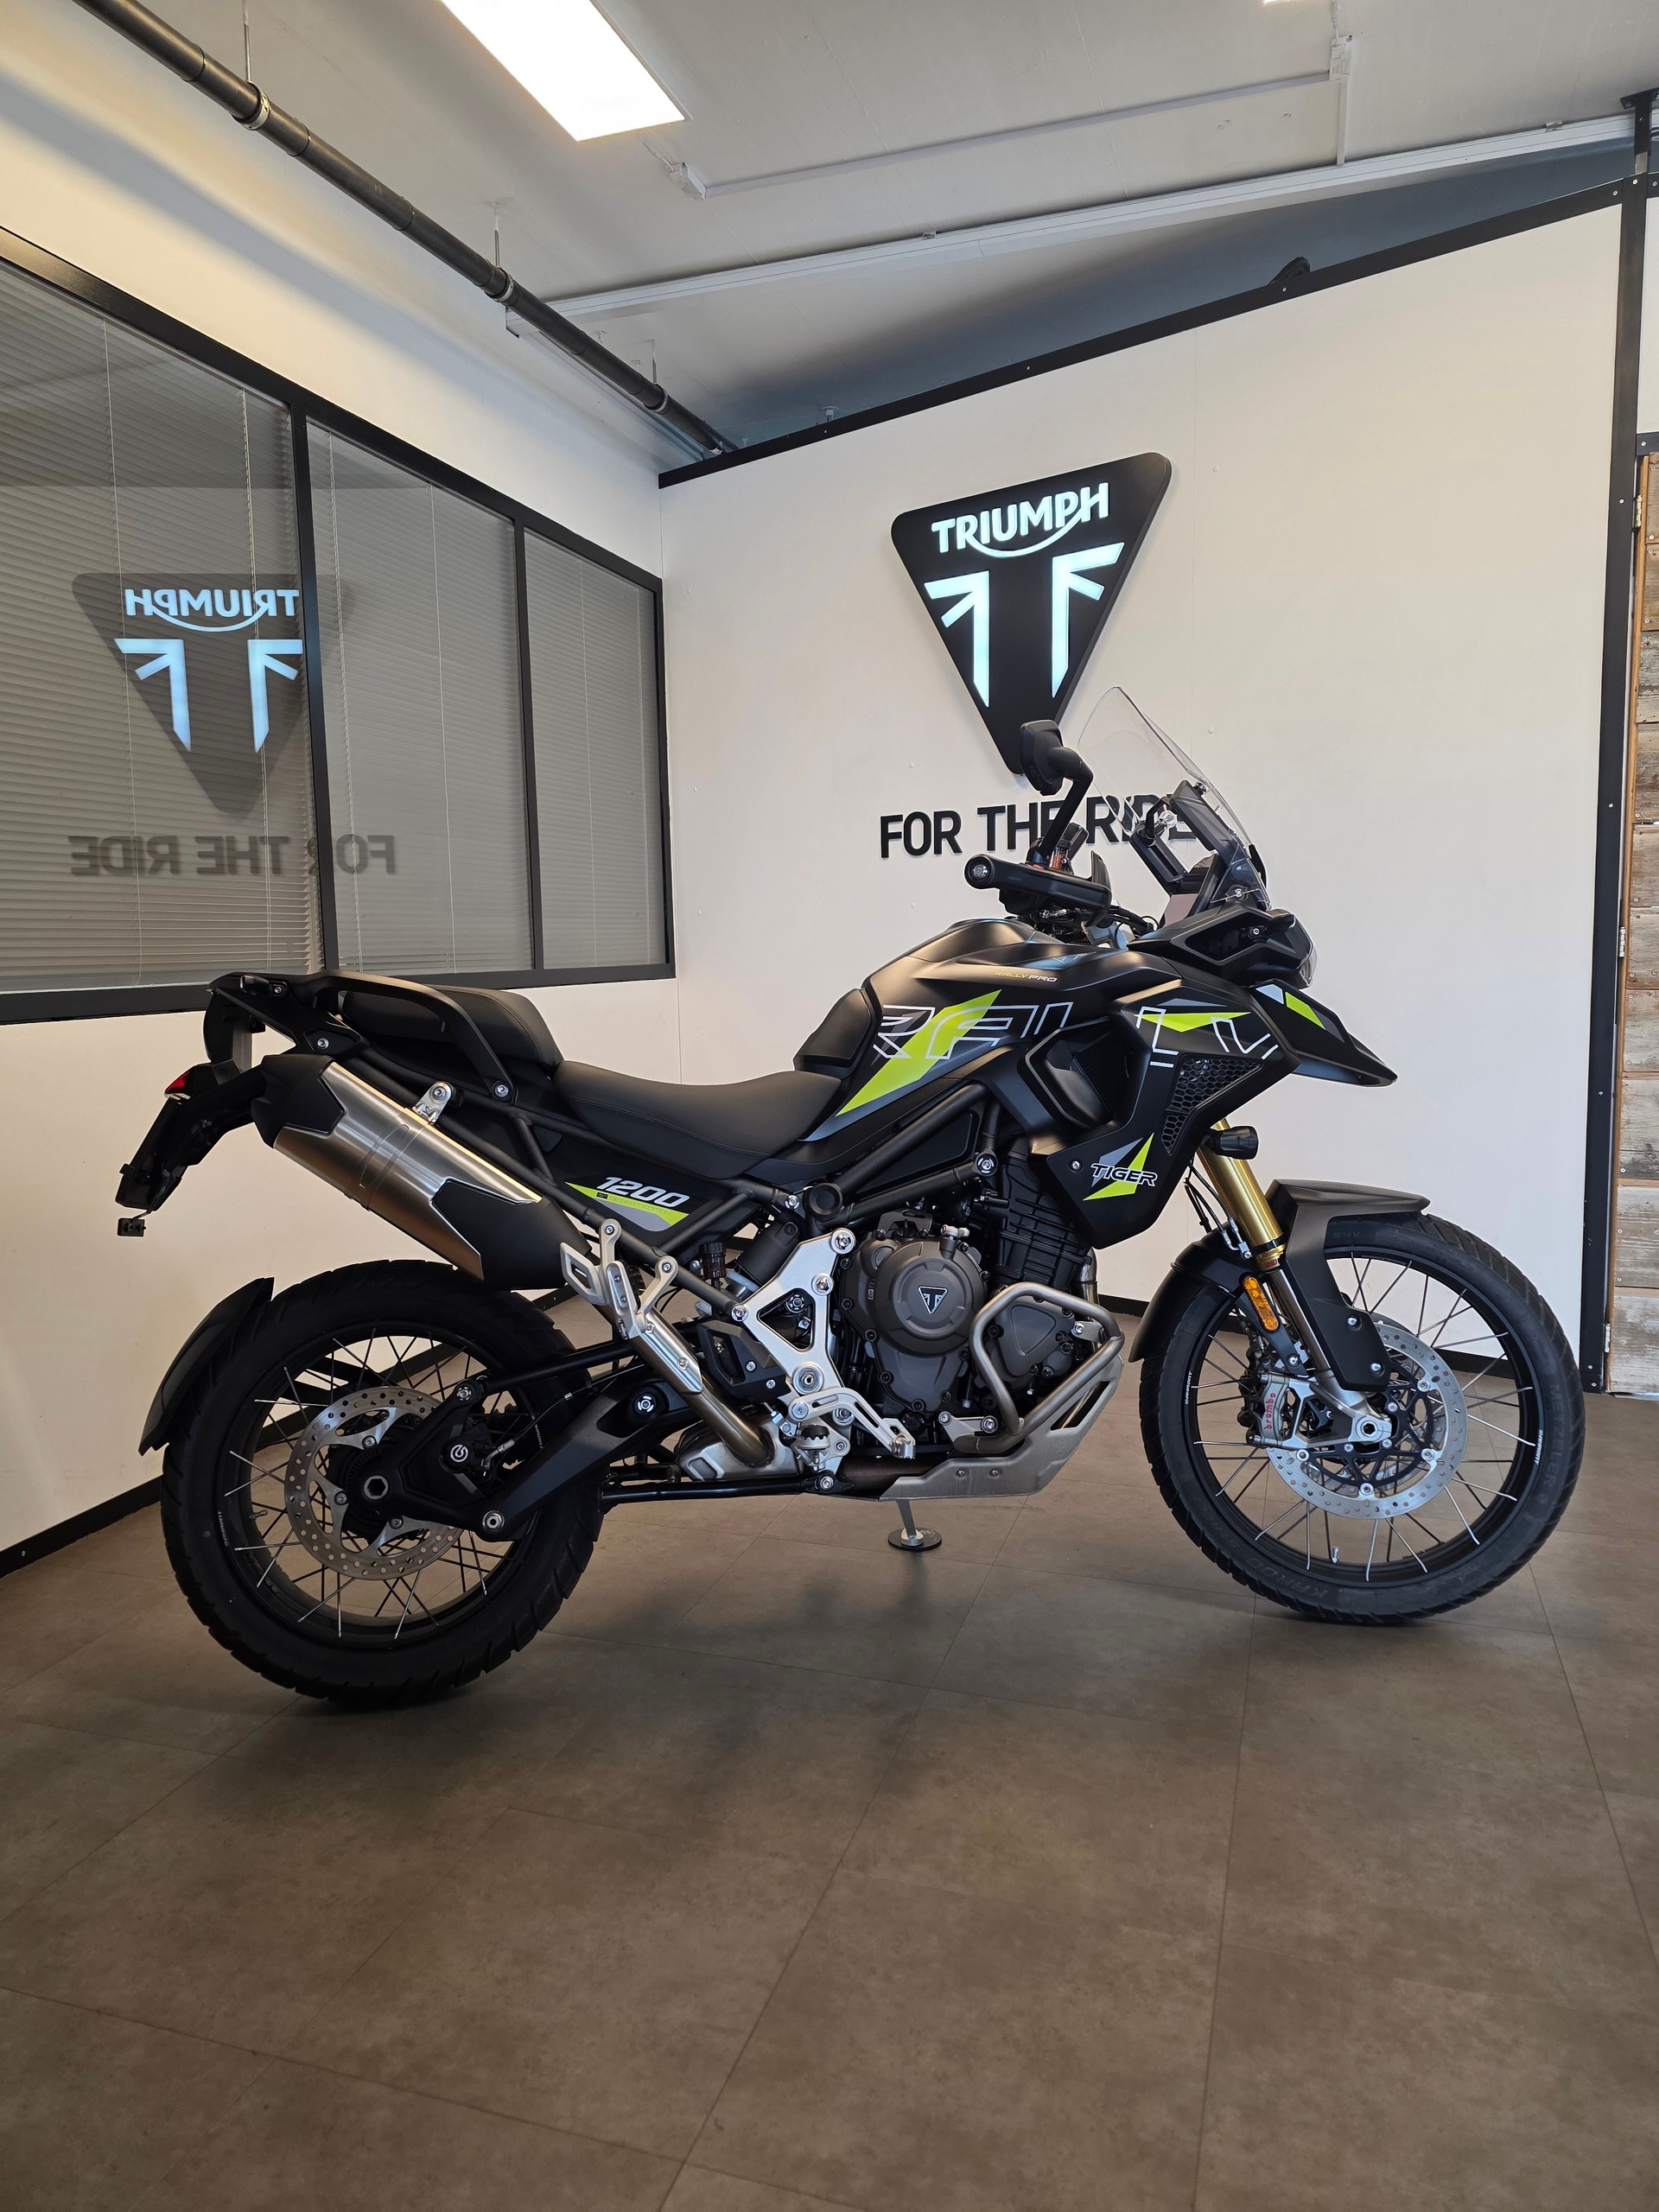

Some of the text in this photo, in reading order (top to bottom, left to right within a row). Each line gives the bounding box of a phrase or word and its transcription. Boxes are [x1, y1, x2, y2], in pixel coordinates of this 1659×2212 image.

[931, 481, 1110, 558] TRIUMPH
[880, 810, 963, 859] FOR
[994, 970, 1029, 979] RALLY
[596, 1177, 690, 1207] 1200
[1090, 1163, 1158, 1186] TIGER
[1264, 1393, 1276, 1430] brembo
[1544, 1383, 1565, 1487] METZELER
[1245, 1557, 1328, 1598] KAROO
